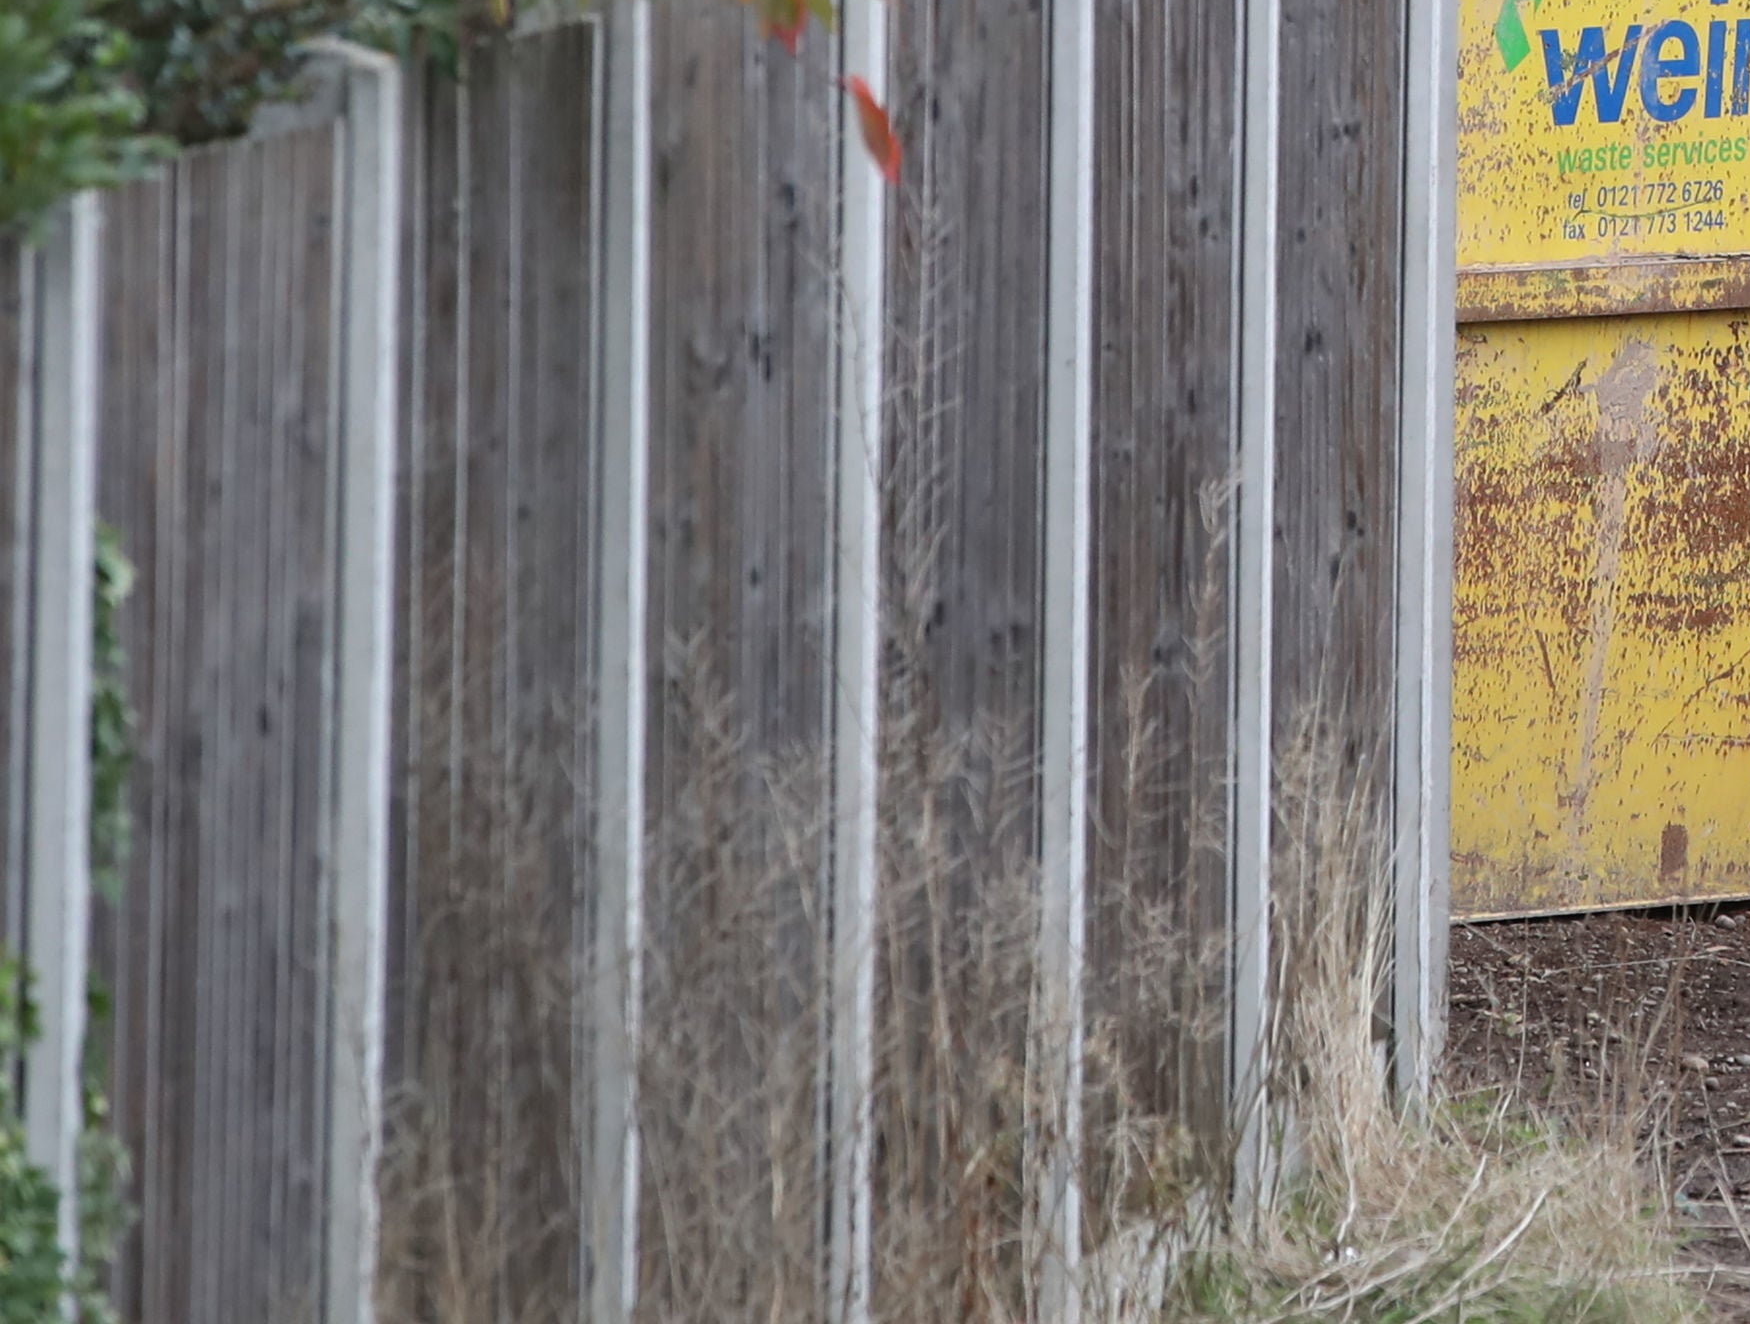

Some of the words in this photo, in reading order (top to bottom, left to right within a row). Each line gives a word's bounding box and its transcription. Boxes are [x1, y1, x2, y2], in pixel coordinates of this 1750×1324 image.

[1557, 142, 1633, 175] waste
[1642, 131, 1748, 169] services
[1568, 188, 1588, 210] tel
[1597, 184, 1638, 208] 0121
[1645, 182, 1677, 204] 772
[1682, 179, 1724, 203] 6726
[1563, 219, 1586, 239] fax
[1598, 216, 1638, 237] 0121
[1646, 212, 1677, 235] 773
[1684, 210, 1725, 233] 1244
